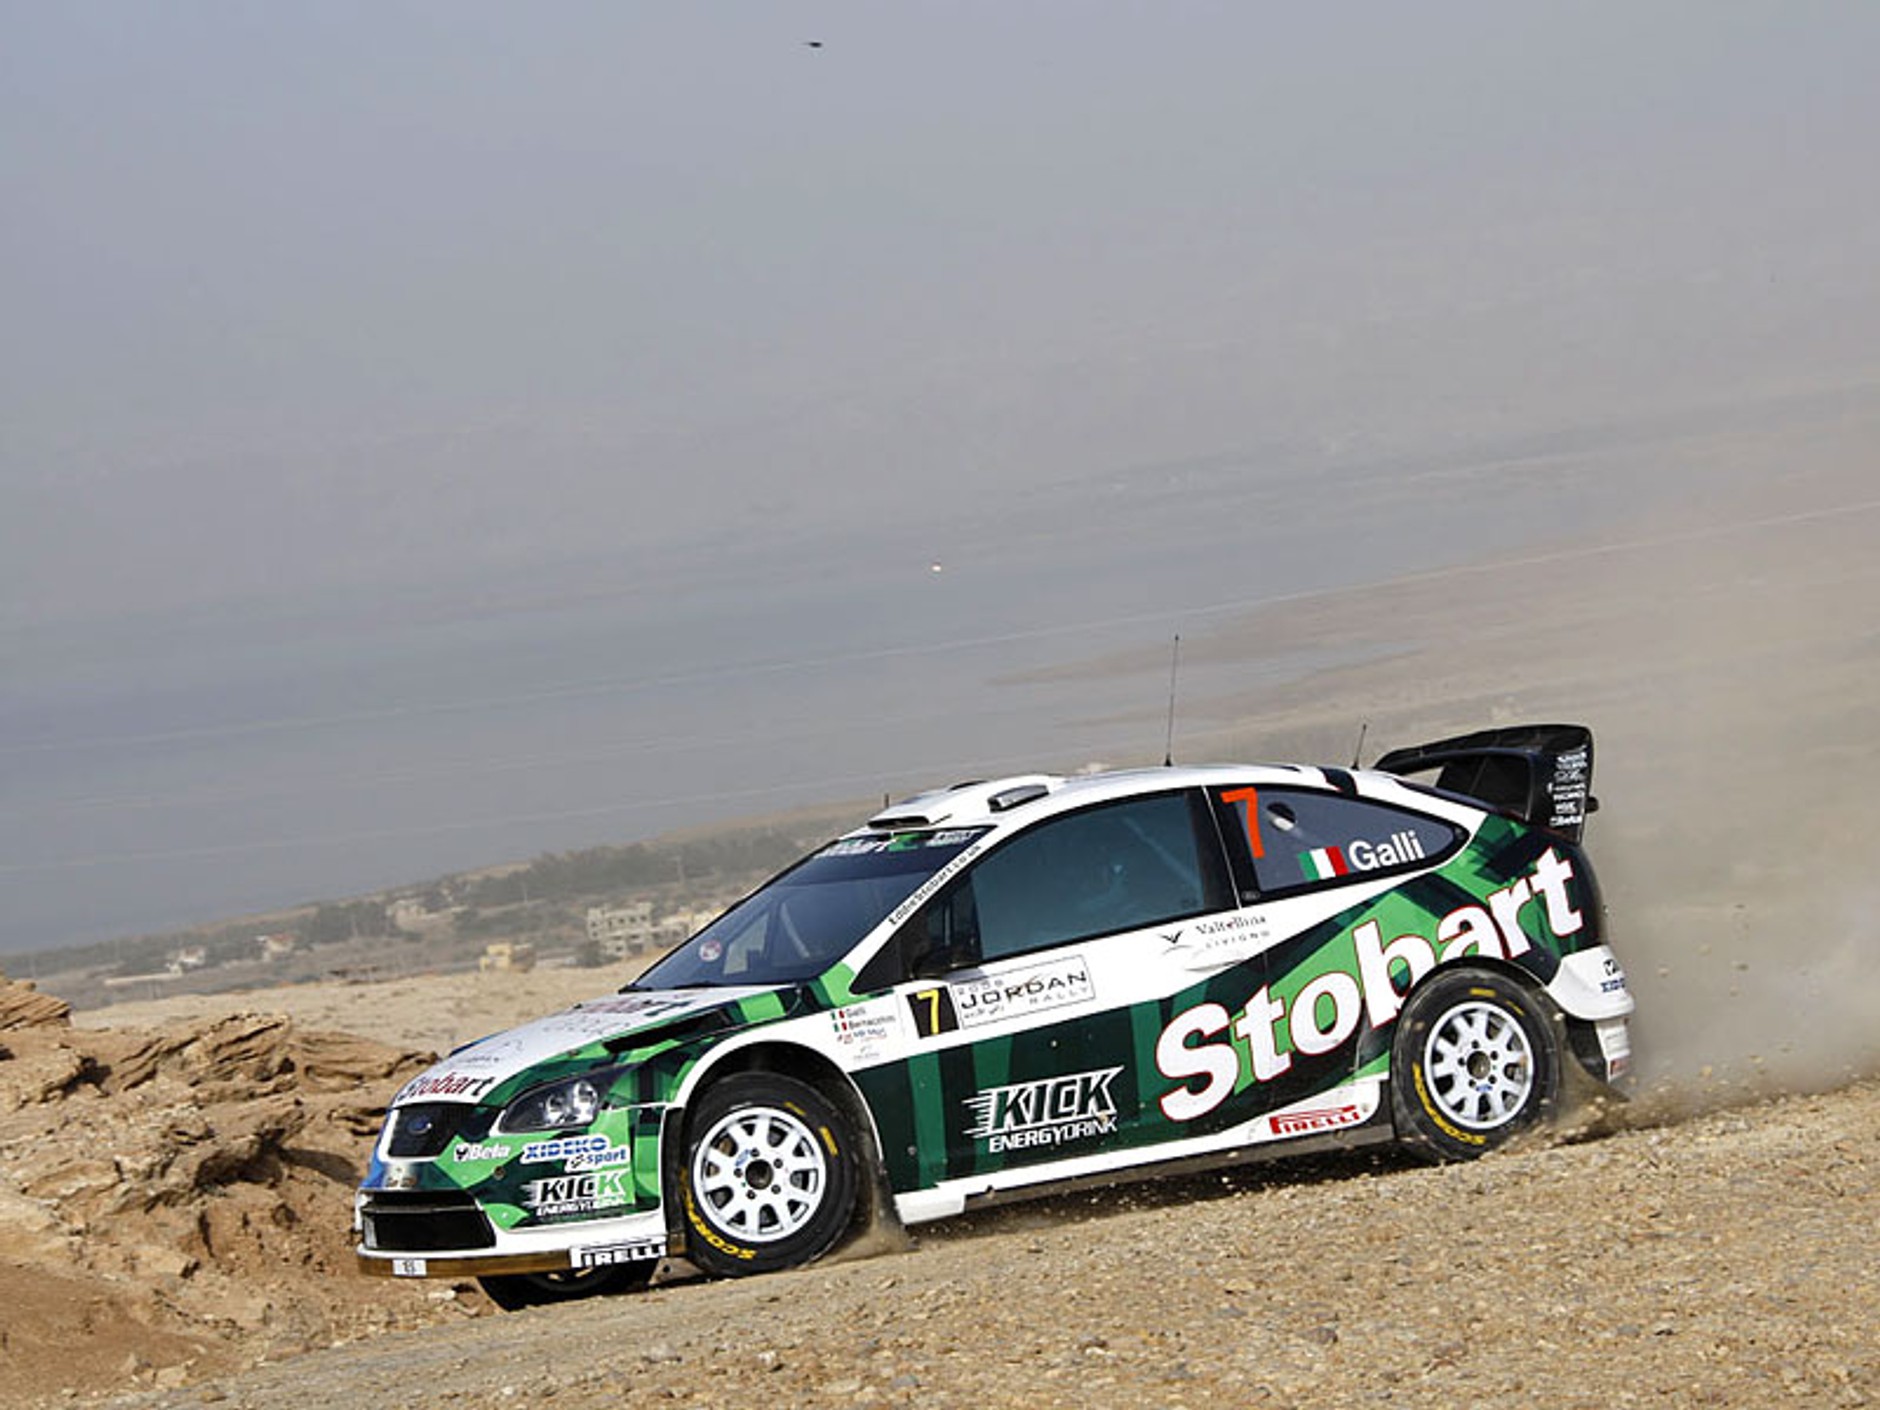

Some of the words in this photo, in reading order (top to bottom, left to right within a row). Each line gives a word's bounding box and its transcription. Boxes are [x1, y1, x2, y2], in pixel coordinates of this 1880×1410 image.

[1220, 786, 1266, 859] 7
[1347, 830, 1426, 872] Galli
[960, 970, 1087, 1010] JORDAN
[1155, 845, 1584, 1123] Stobart
[916, 988, 942, 1035] 7
[397, 1072, 496, 1102] Stobart
[991, 1070, 1119, 1132] KICK
[1269, 1104, 1360, 1135] PIRELLI
[469, 1142, 512, 1160] Beta
[588, 1148, 627, 1165] sport
[539, 1172, 624, 1203] KICK
[571, 1238, 667, 1268] PIRELLI
